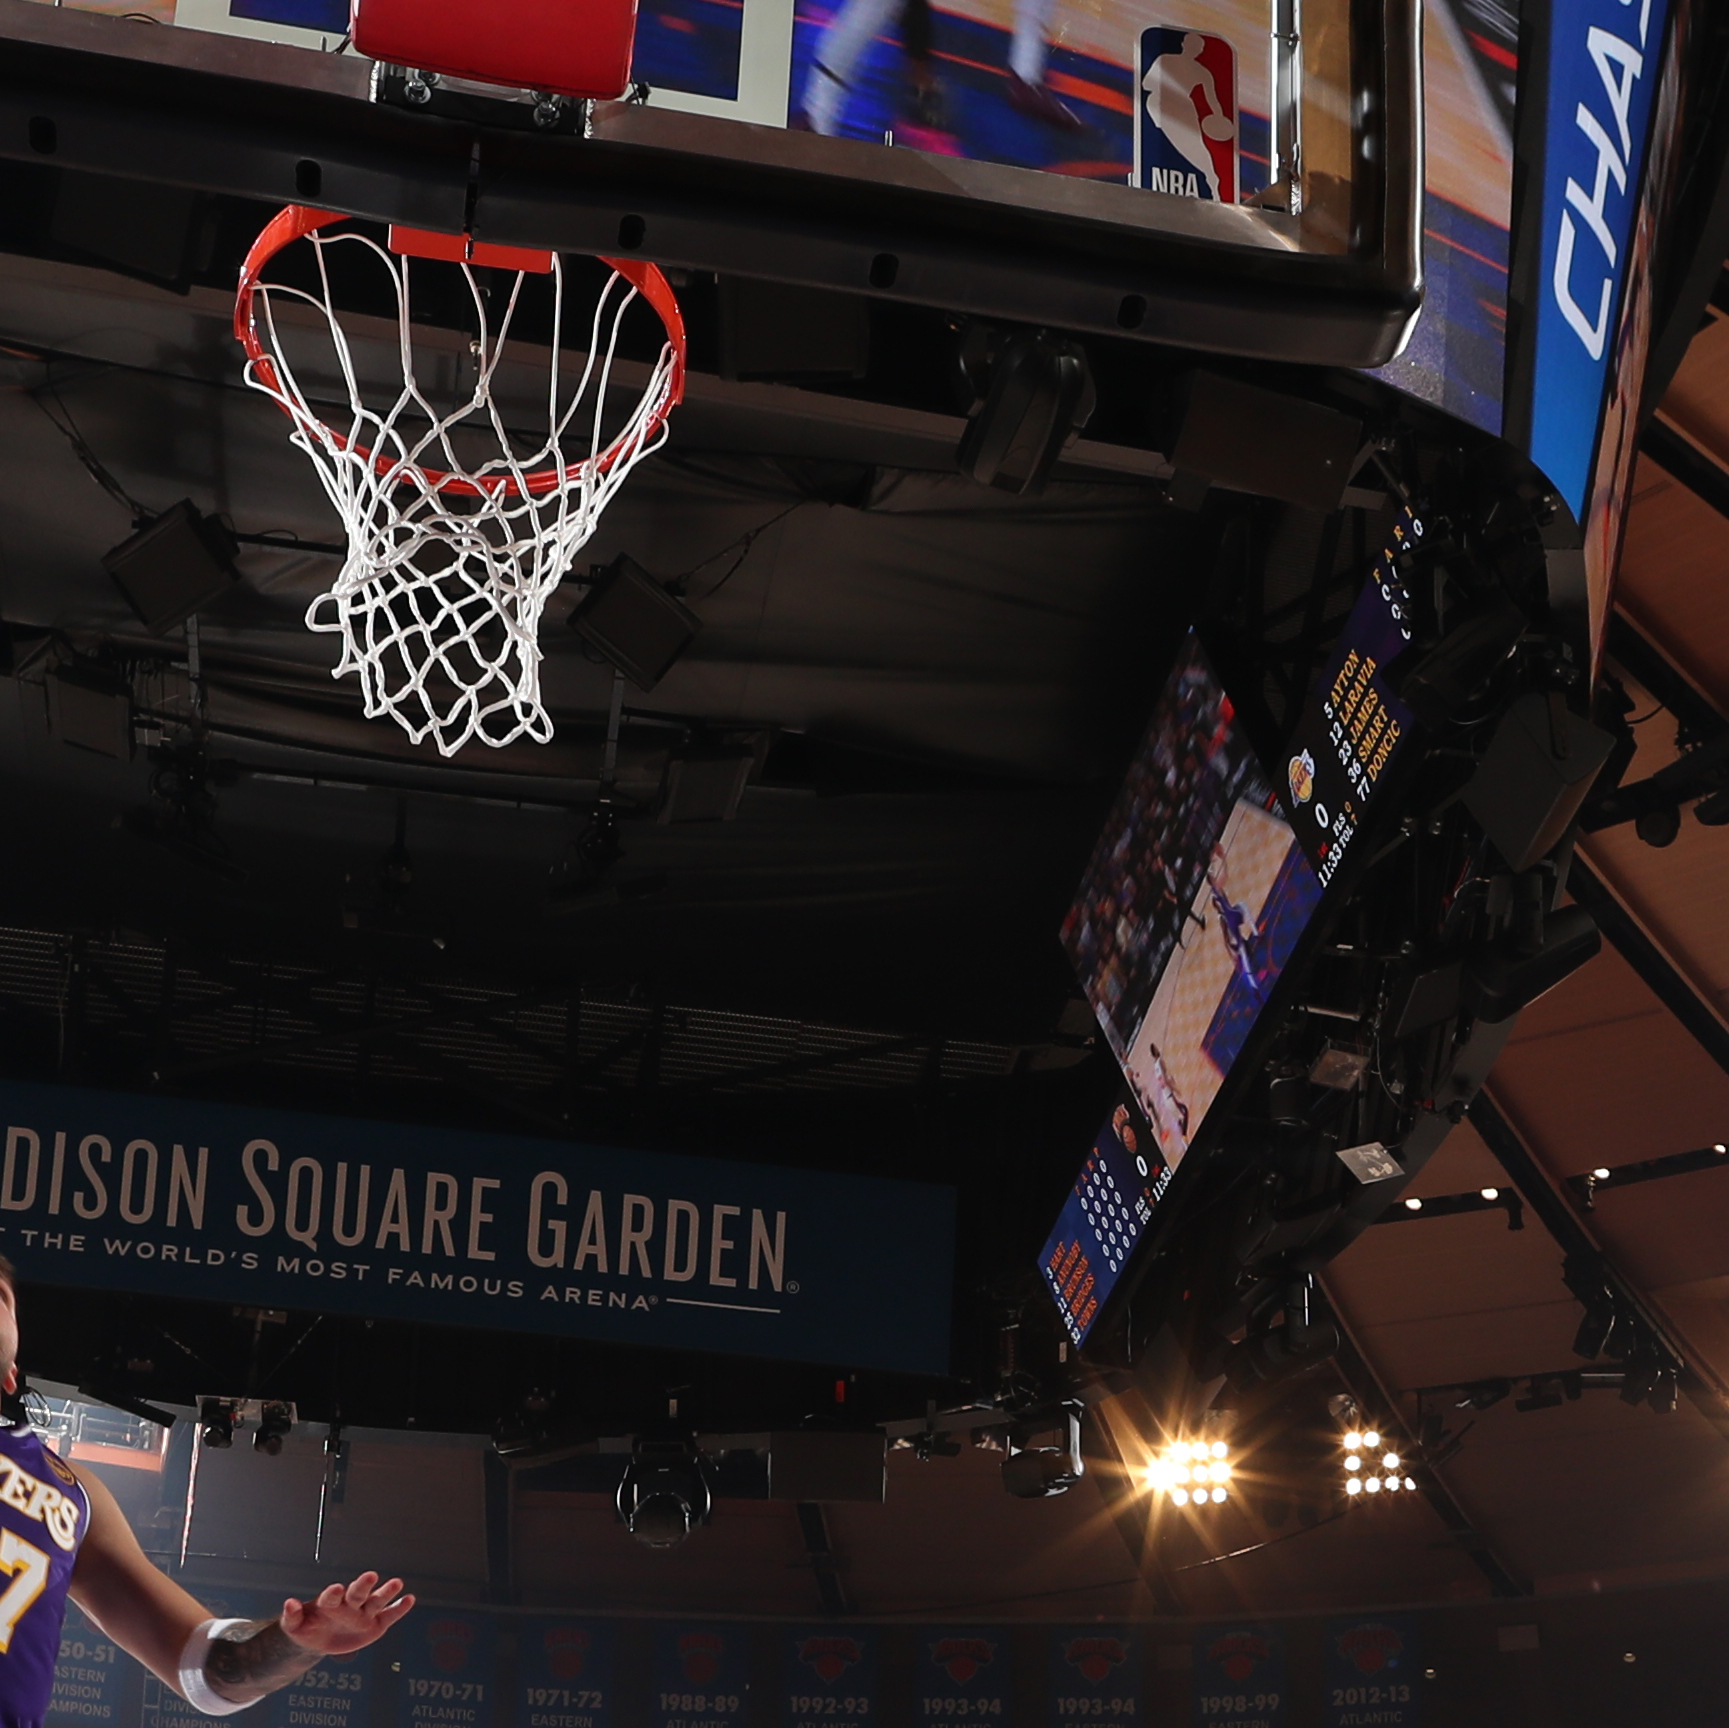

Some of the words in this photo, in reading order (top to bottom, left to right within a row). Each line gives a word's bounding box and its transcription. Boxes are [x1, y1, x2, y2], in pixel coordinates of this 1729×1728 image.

[1151, 166, 1201, 200] NBA
[1330, 649, 1360, 707] AYTON
[1329, 721, 1343, 746] 12
[1339, 657, 1377, 726] LARAVIA
[1338, 740, 1352, 765] 23
[1348, 687, 1379, 744] JAMES
[1347, 758, 1362, 782] 36
[1357, 705, 1388, 763] SMART
[1356, 777, 1371, 802] 77
[1366, 720, 1401, 782] DONCIC
[1314, 803, 1328, 828] 0
[1318, 844, 1343, 888] 11:33
[1136, 1155, 1148, 1177] 0
[1152, 1166, 1172, 1201] 11:33
[235, 1138, 501, 1262] SQUARE
[20, 1228, 86, 1252] THE
[103, 1237, 259, 1270] WORLD'S
[276, 1255, 371, 1281] MOST
[387, 1268, 524, 1297] FAMOUS
[408, 1678, 484, 1702] 1970-71
[526, 1688, 603, 1709] 1971-72
[1332, 1685, 1411, 1707] 2012-13
[288, 1694, 351, 1710] EASTERN
[660, 1693, 740, 1712] 1988-89
[790, 1696, 869, 1714] 1992-93
[923, 1698, 1001, 1715] 1993-94
[1057, 1698, 1136, 1715] 1993-94
[1200, 1693, 1280, 1714] 1998-99
[290, 1711, 347, 1727] DIVISION
[411, 1705, 476, 1722] ATLANTIC
[531, 1714, 593, 1728] EASTERN
[1339, 1712, 1402, 1726] ATLANTIC
